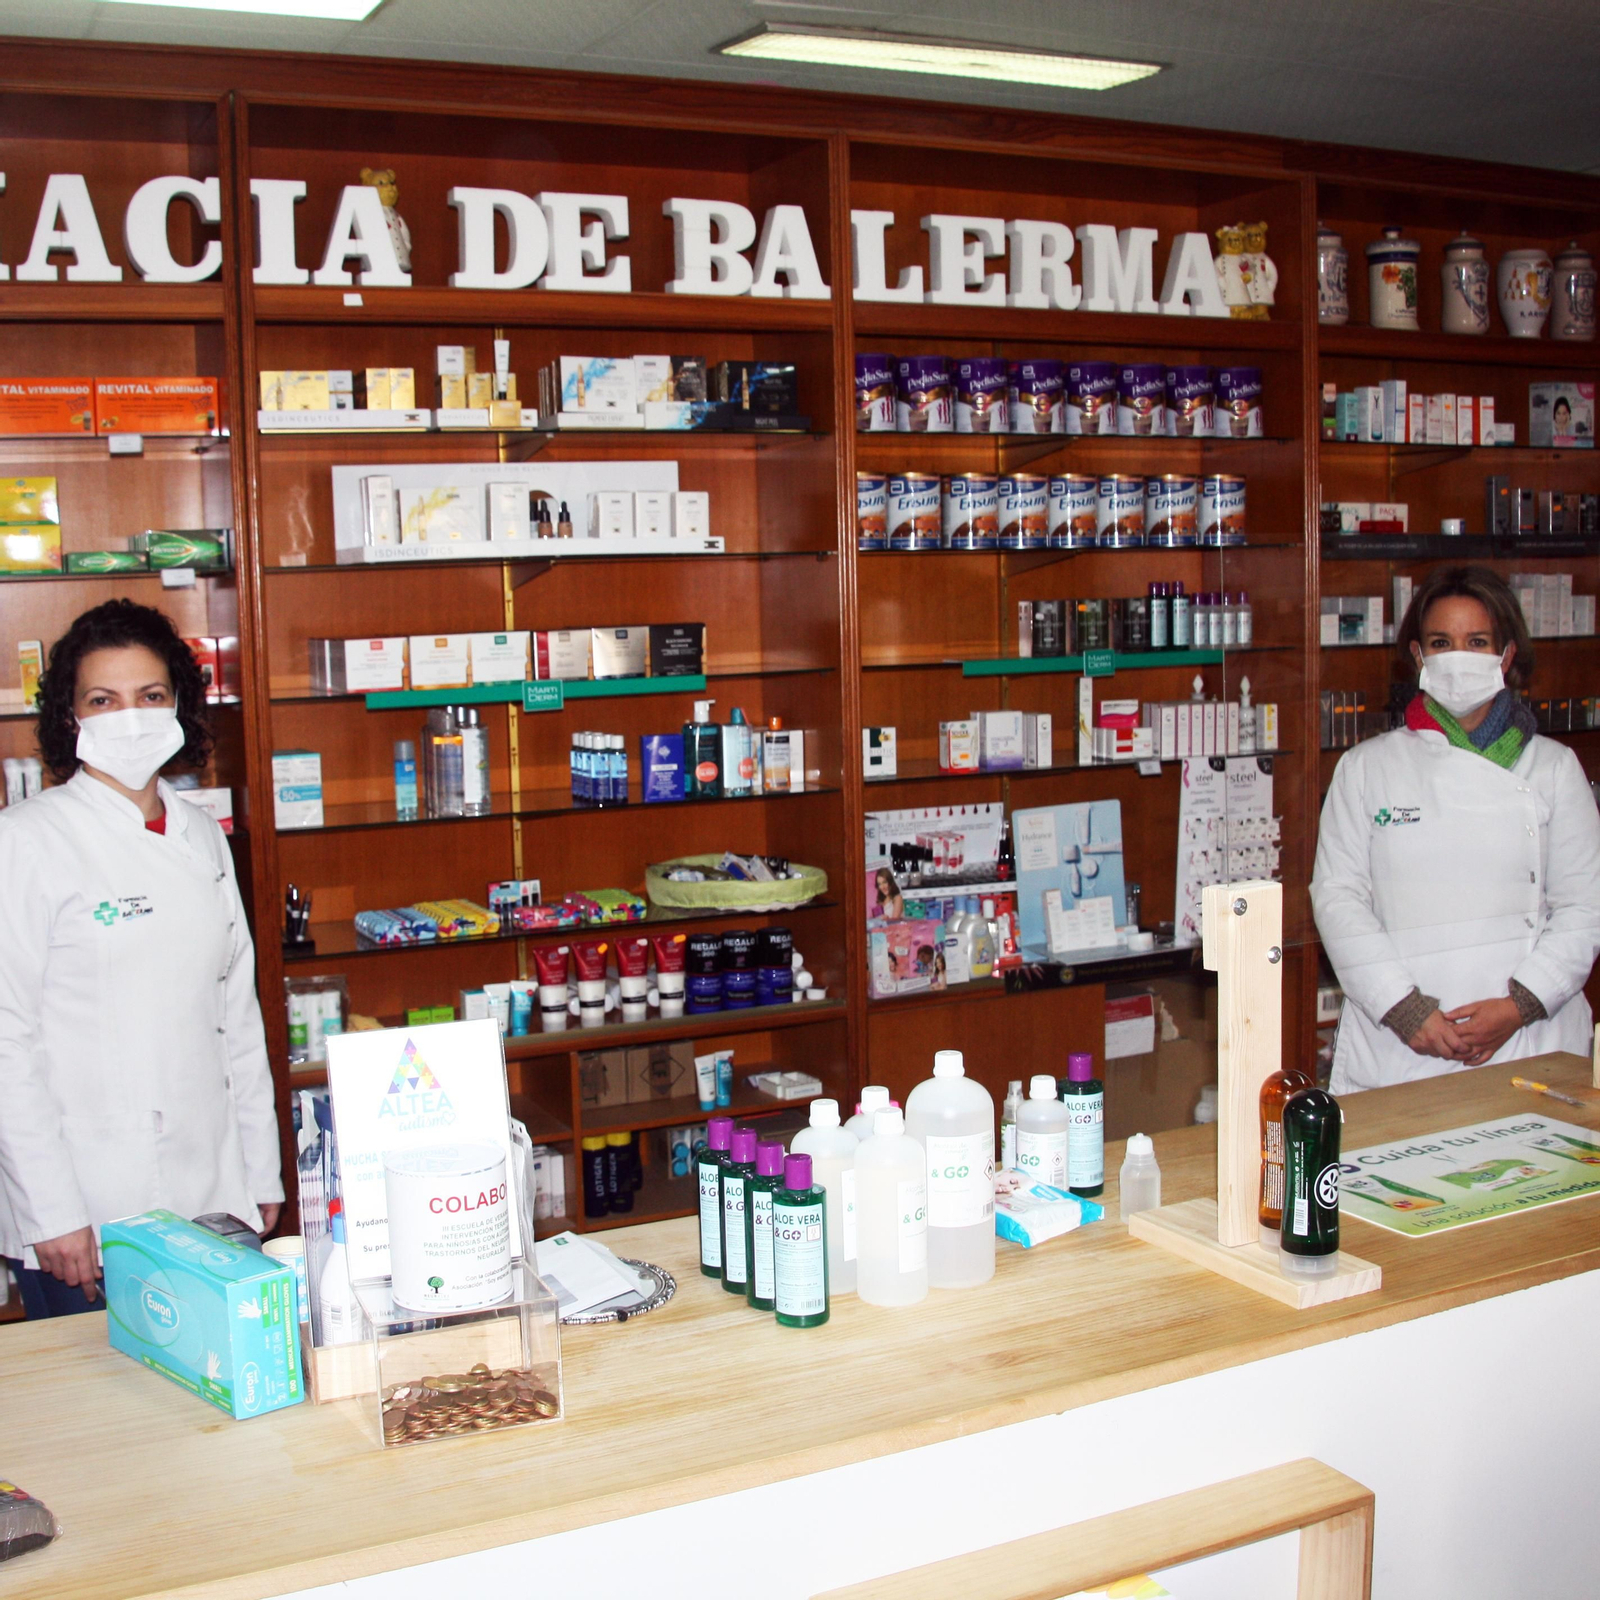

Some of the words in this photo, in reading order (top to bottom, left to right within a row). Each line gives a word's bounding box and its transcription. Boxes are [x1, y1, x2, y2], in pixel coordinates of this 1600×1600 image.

[447, 186, 632, 293] DE
[663, 197, 1231, 318] BALERMA
[28, 386, 90, 395] VITAMINADO
[98, 384, 152, 394] REVITAL
[153, 385, 214, 395] VITAMINADO
[898, 496, 940, 510] Ensure
[1154, 496, 1195, 510] Ensure
[374, 547, 454, 558] ISDINCEUTICS
[527, 686, 558, 694] MARTI
[527, 693, 558, 702] DERM
[1195, 774, 1214, 783] steel
[1230, 771, 1257, 783] steel
[1021, 832, 1053, 843] Hydrance
[723, 937, 755, 946] REGALO
[378, 1091, 453, 1118] ALTEA
[1067, 1103, 1086, 1111] ALOE
[1357, 1143, 1443, 1166] Cuida
[1443, 1134, 1476, 1148] tu
[1475, 1121, 1548, 1141] línea
[344, 1151, 379, 1166] HUCHA
[357, 1171, 375, 1181] con
[931, 1168, 939, 1178] &
[700, 1187, 706, 1196] &
[708, 1187, 719, 1198] G
[725, 1185, 743, 1197] ALO
[429, 1180, 507, 1214] COLABO
[726, 1200, 733, 1211] &
[847, 1202, 853, 1212] &
[1412, 1216, 1449, 1229] Una
[1449, 1200, 1516, 1221] solución
[1515, 1198, 1528, 1206] a
[1529, 1192, 1547, 1201] tu
[1547, 1179, 1600, 1197] medida
[451, 1220, 484, 1231] ESCUELA
[485, 1217, 494, 1225] DE
[755, 1214, 763, 1225] &
[774, 1214, 794, 1226] ALOE
[797, 1212, 821, 1224] VERA
[903, 1214, 911, 1224] &
[441, 1227, 494, 1240] INTERVENCIÓN
[774, 1227, 781, 1238] &
[446, 1238, 482, 1248] NIÑOS/AS
[482, 1234, 495, 1243] CON
[363, 1244, 372, 1252] Su
[425, 1247, 476, 1257] TRASTORNOS
[477, 1244, 490, 1252] DEL
[476, 1245, 506, 1260] NEURALBA
[451, 1281, 483, 1290] Asociación
[146, 1293, 172, 1318] Euron
[245, 1370, 255, 1404] Euron
[289, 1379, 297, 1393] 100
